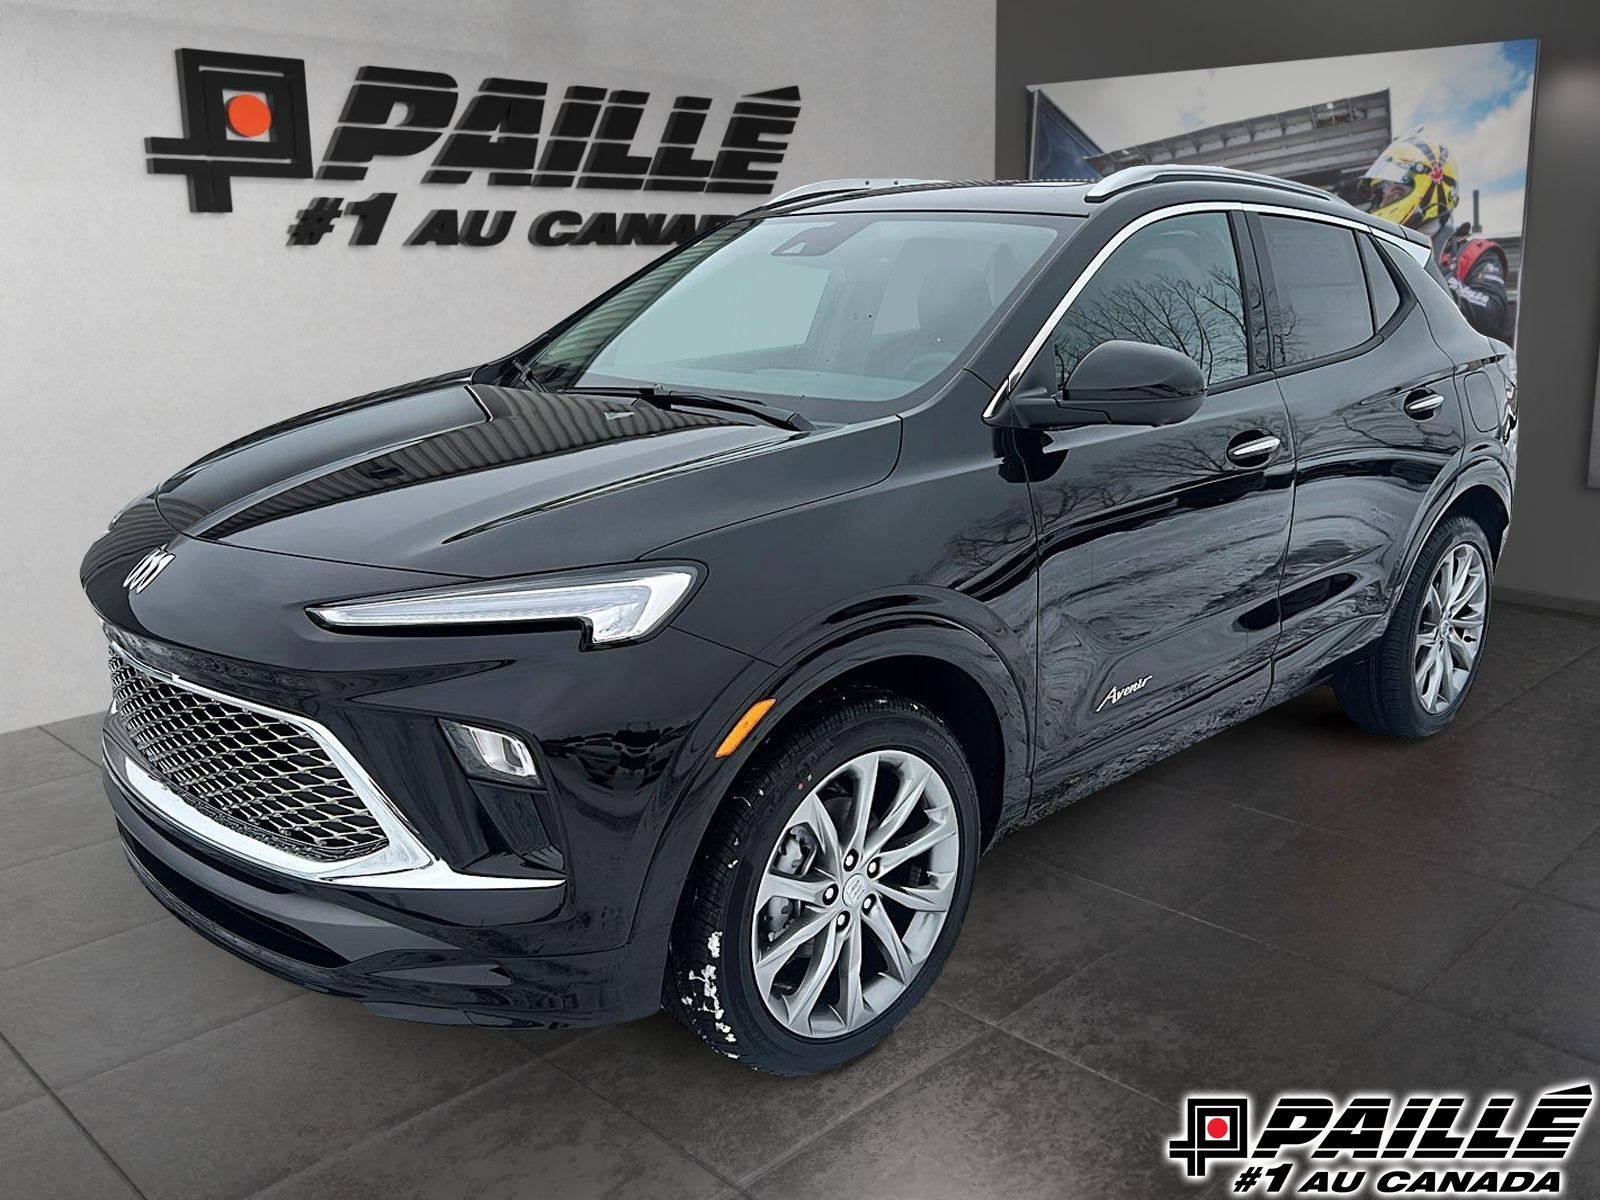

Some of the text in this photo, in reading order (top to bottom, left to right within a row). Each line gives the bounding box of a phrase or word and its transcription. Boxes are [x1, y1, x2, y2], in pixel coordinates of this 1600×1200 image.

[314, 65, 801, 194] PAILLÉ
[287, 193, 739, 247] #1 AU CANA
[1096, 675, 1153, 712] Avenir
